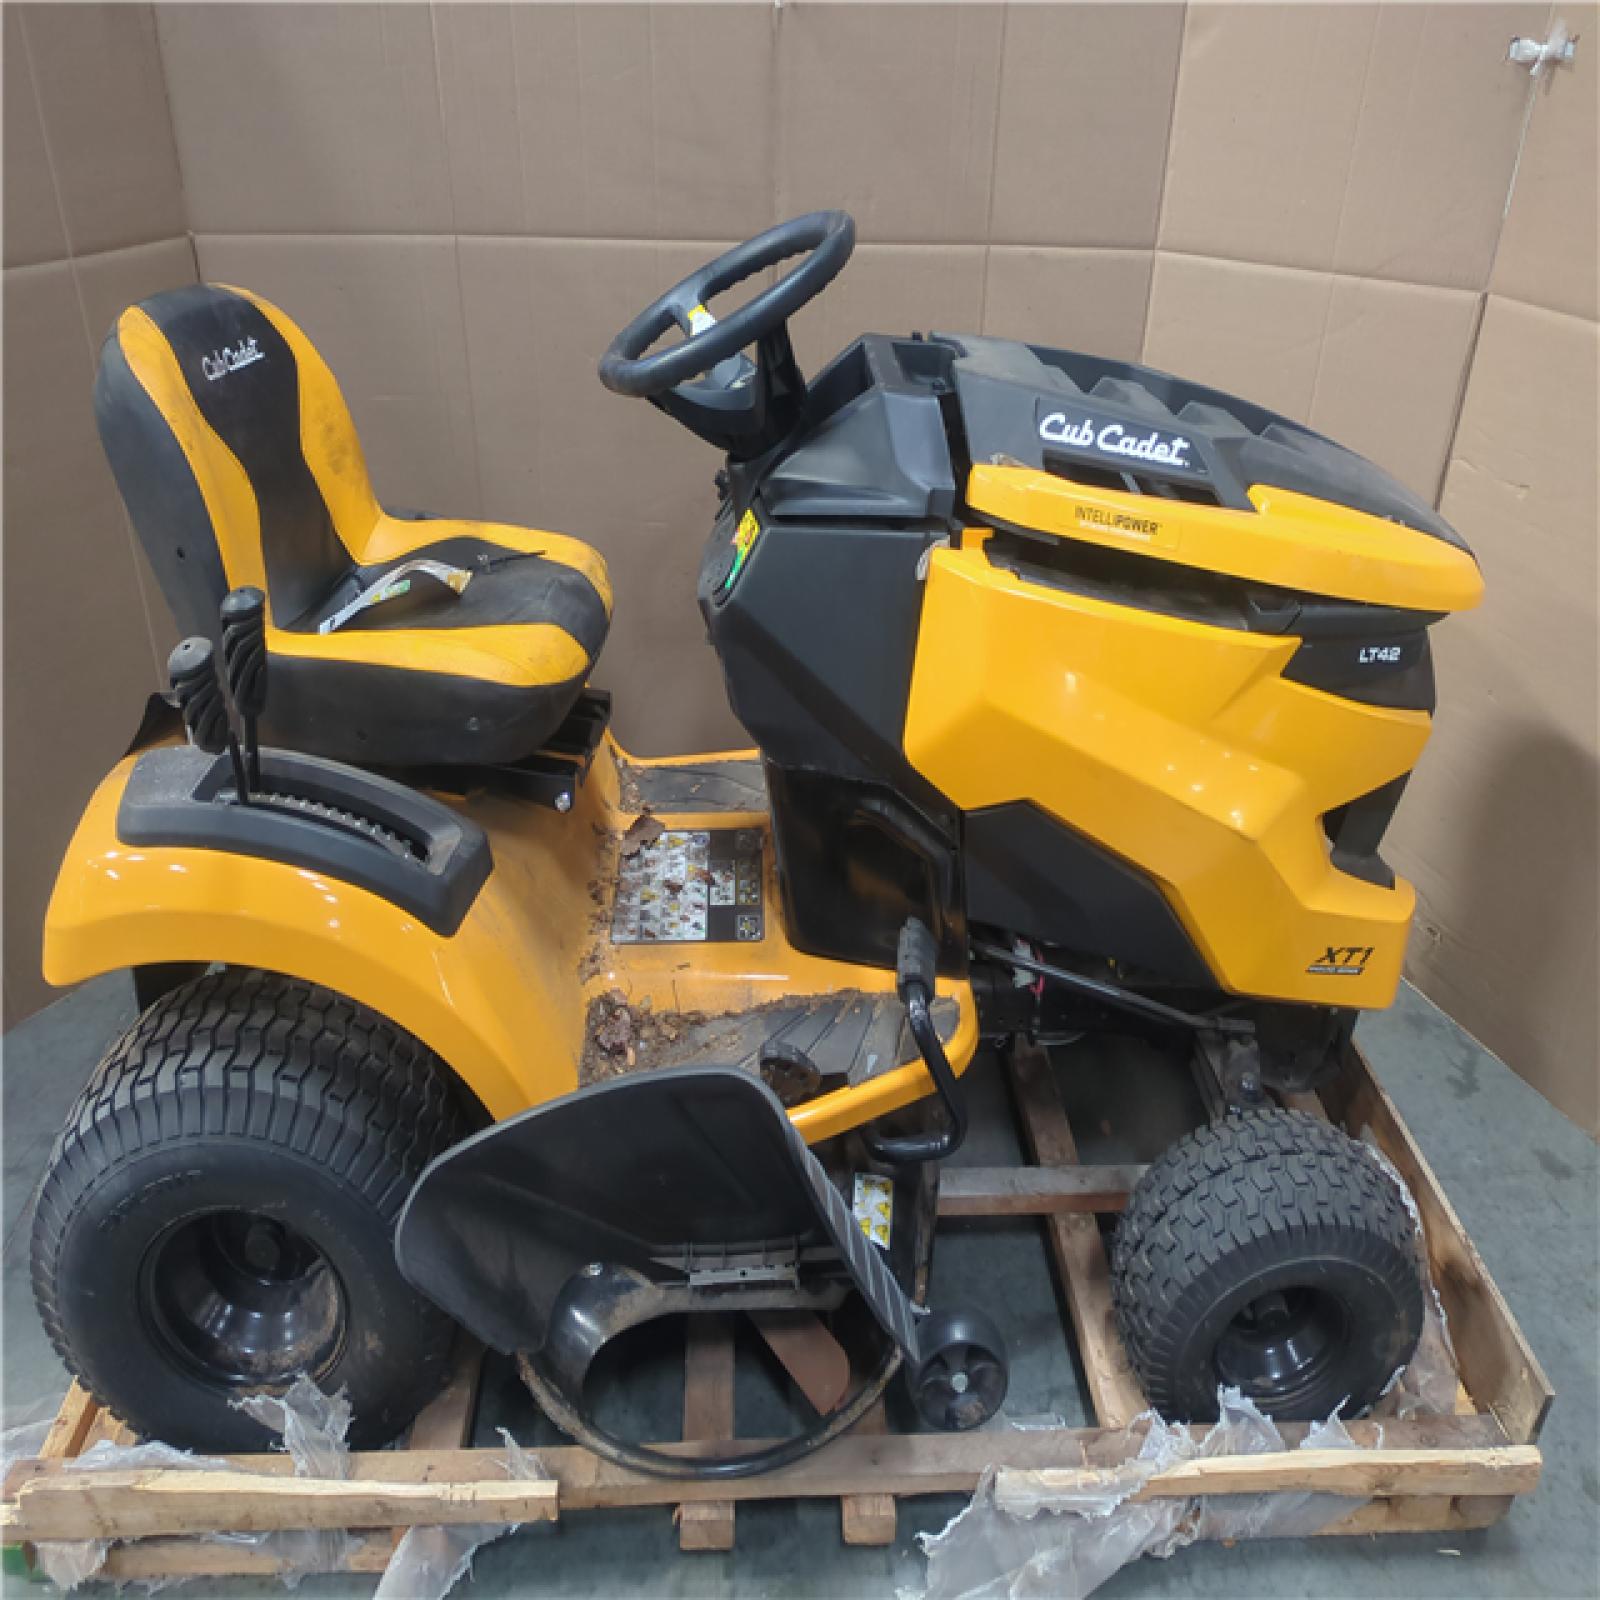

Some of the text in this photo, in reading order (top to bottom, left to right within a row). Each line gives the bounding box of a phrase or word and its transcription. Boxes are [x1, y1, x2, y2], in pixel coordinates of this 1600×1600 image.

[202, 335, 265, 381] Cub Cadet
[1039, 412, 1191, 467] Cub Cadet
[1074, 504, 1159, 535] INTELLIPOWER
[1359, 646, 1401, 664] LT42
[1314, 946, 1375, 967] XT1
